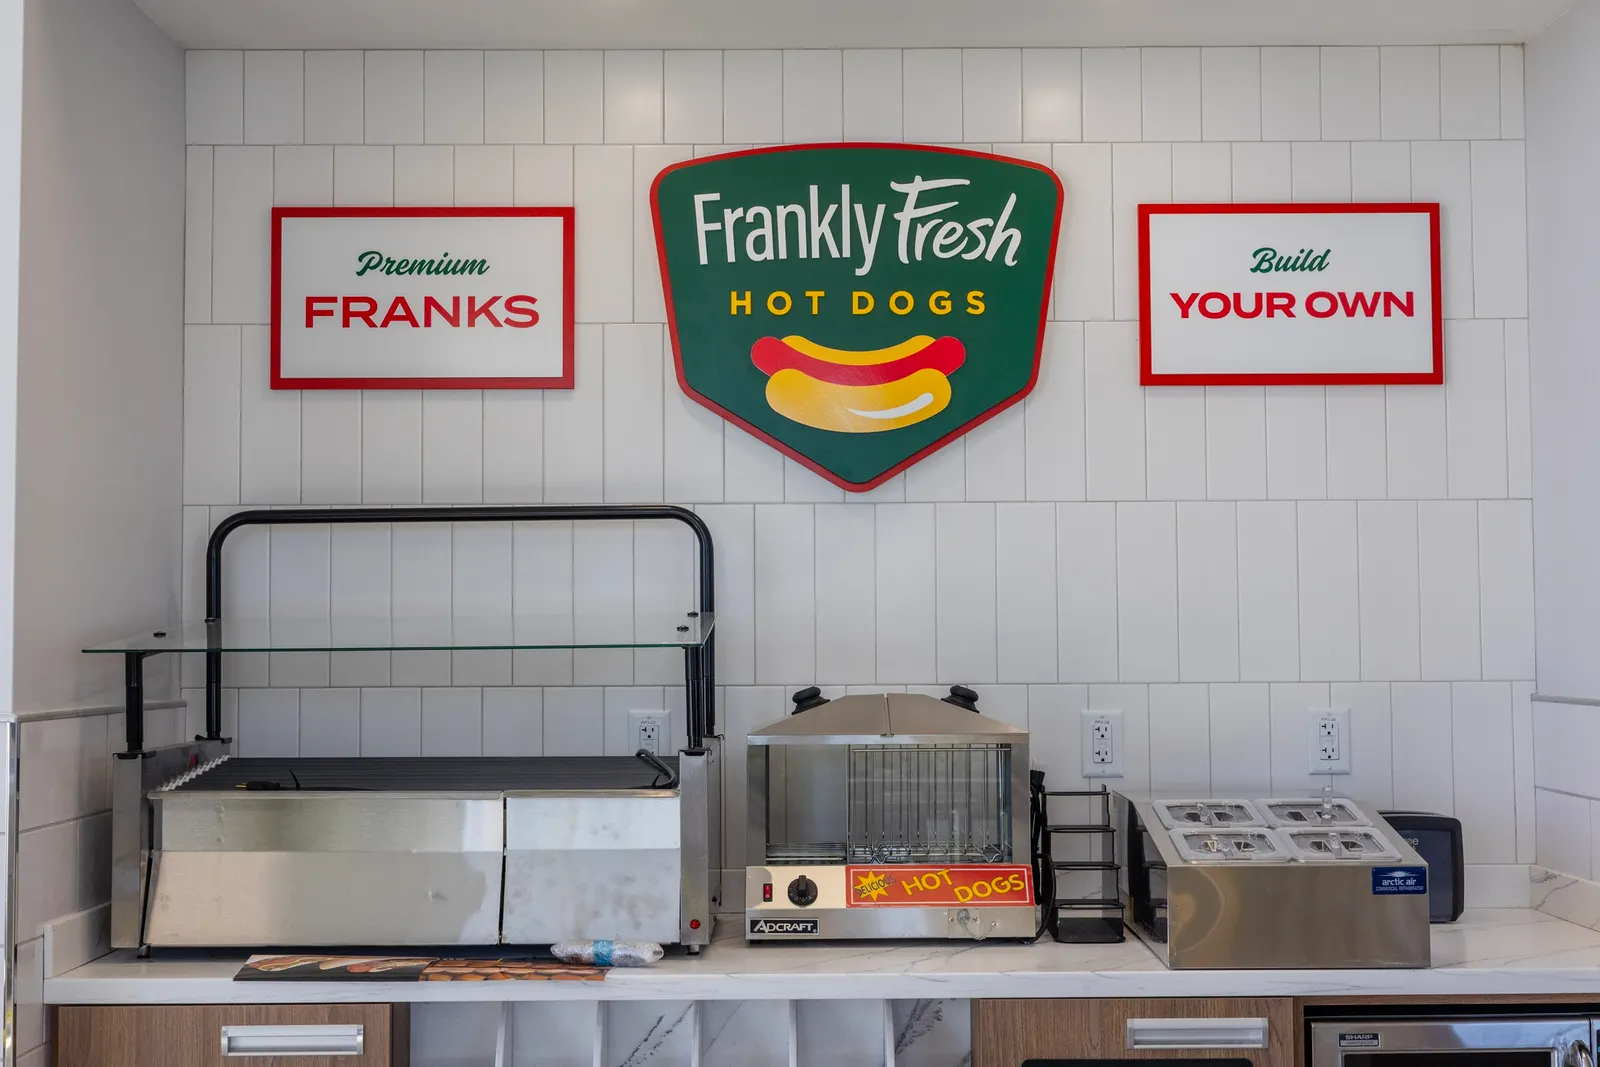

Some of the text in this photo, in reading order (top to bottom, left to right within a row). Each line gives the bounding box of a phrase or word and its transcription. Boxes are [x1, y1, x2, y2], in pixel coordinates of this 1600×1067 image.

[693, 175, 1022, 276] Frankly Fresh
[356, 251, 490, 277] Premium
[1250, 247, 1331, 274] Build
[305, 295, 540, 328] FRANKS
[730, 290, 986, 316] HOT DOGS
[1169, 291, 1415, 319] YOUR OWN
[853, 868, 1026, 903] DELICIOUS HOT DOGS
[1382, 878, 1404, 886] arctic
[753, 919, 814, 934] ADCRAFT
